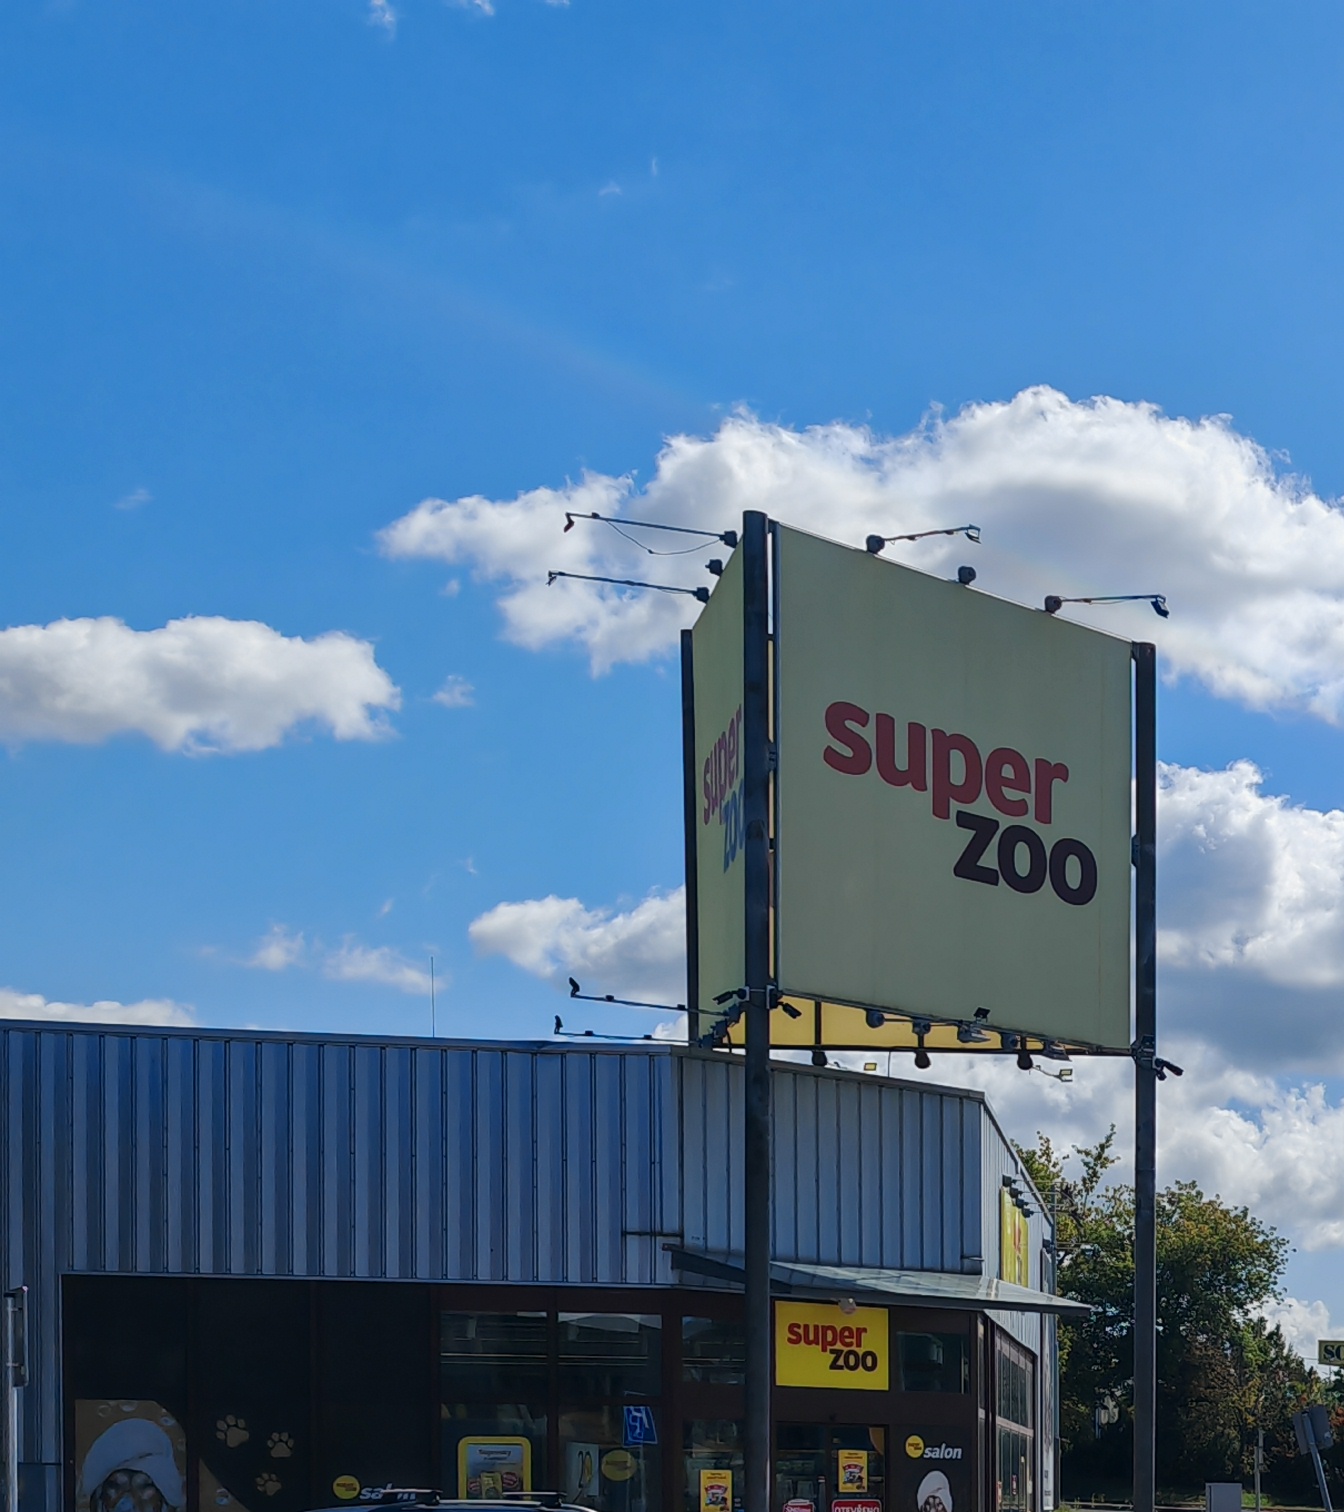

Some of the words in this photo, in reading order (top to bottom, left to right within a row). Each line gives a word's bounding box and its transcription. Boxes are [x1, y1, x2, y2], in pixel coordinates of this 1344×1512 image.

[704, 703, 742, 826] super
[824, 701, 1069, 824] super
[953, 811, 1098, 905] zoo
[787, 1322, 868, 1352] super
[829, 1348, 878, 1372] zoo
[923, 1443, 962, 1459] salon
